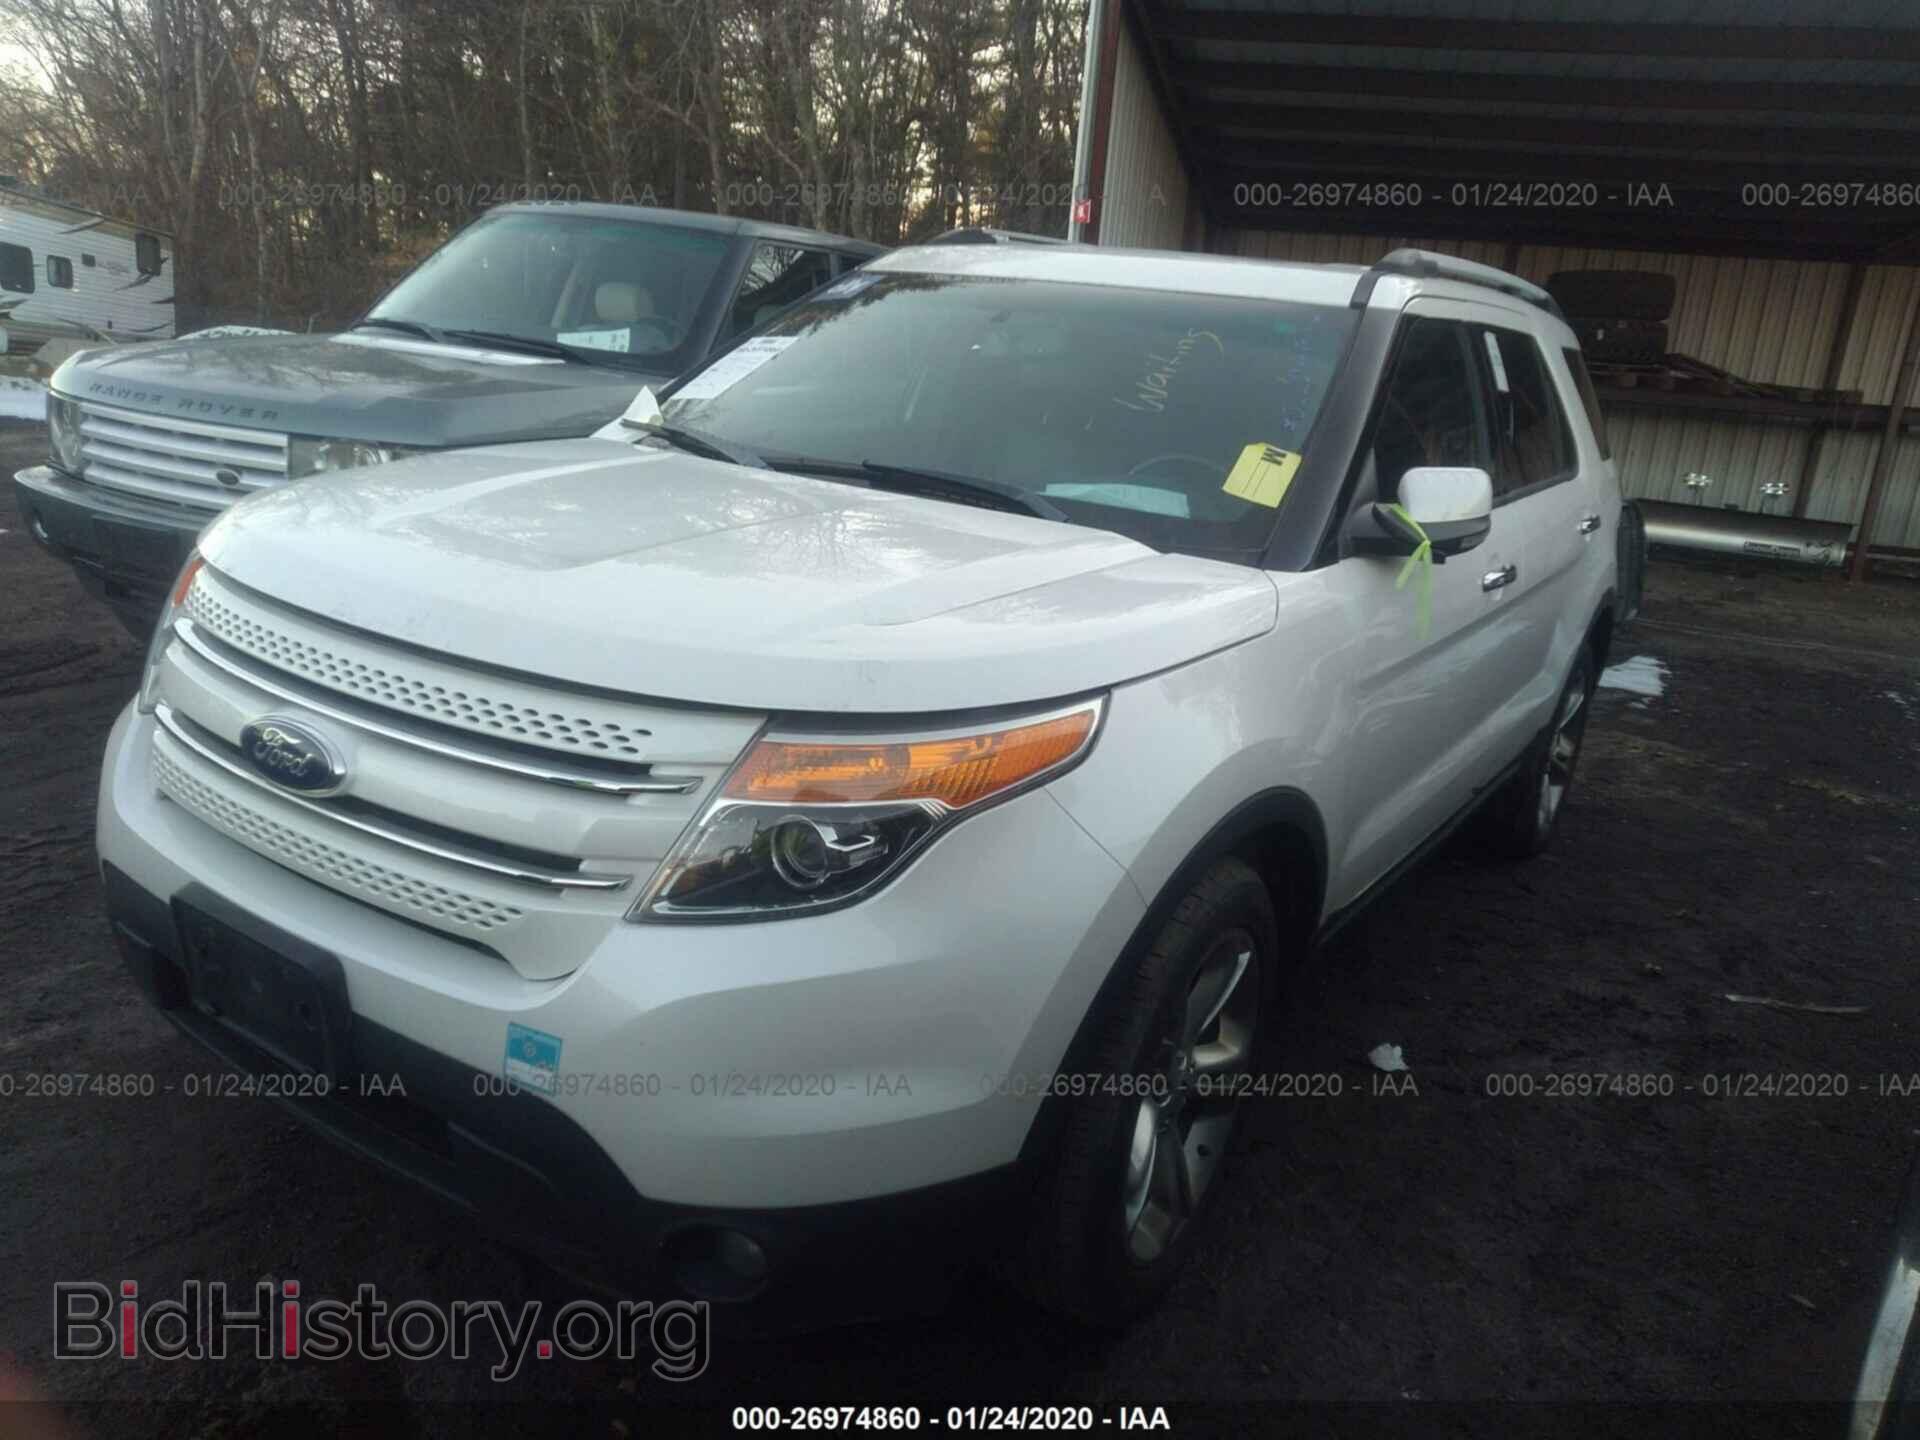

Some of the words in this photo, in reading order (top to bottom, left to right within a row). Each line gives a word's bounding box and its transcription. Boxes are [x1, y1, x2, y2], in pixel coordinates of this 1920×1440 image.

[89, 383, 164, 402] RANGE
[178, 399, 279, 421] ROVER
[254, 727, 314, 777] Ford
